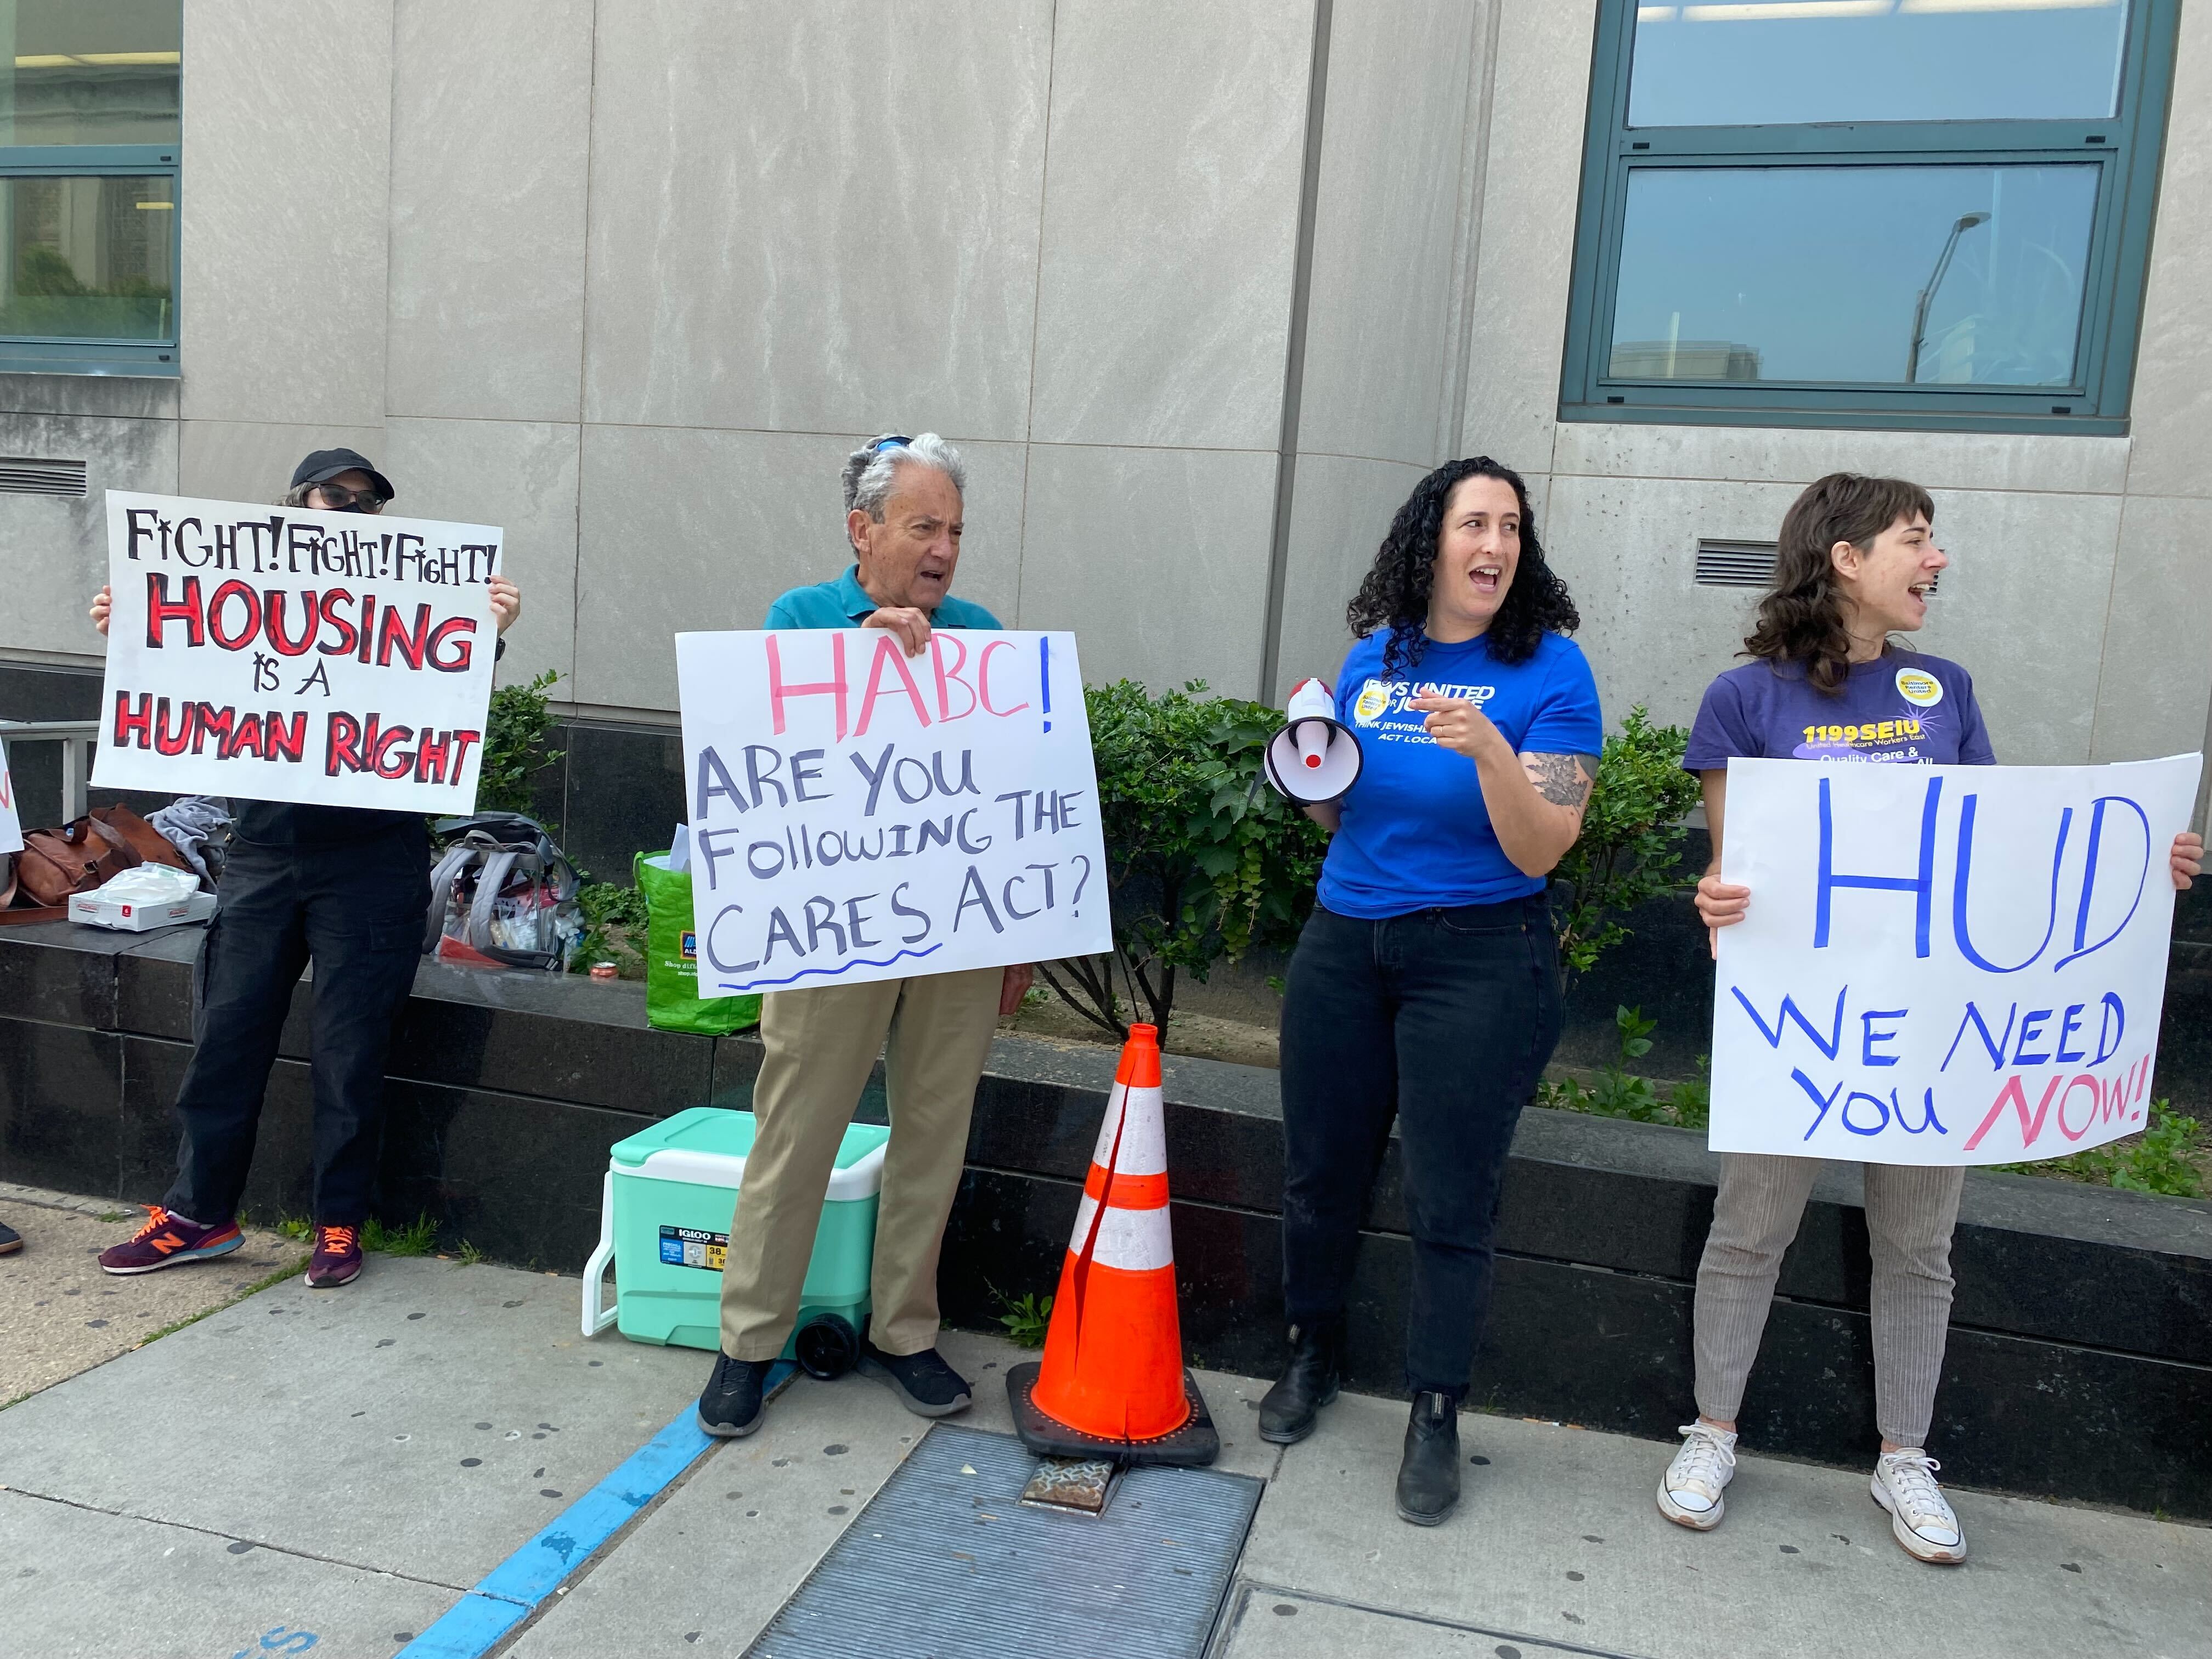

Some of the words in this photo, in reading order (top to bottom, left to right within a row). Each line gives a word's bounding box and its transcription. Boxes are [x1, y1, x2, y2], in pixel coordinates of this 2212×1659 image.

[146, 572, 477, 673] HOUSING
[294, 658, 331, 697] A
[1412, 682, 1496, 701] UNITED
[114, 690, 308, 762] HUMAN
[325, 712, 481, 787] RIGHT
[1355, 720, 1381, 730] THINK
[1378, 733, 1403, 742] ACT
[1802, 719, 1921, 743] 1199SEIU
[1874, 736, 1908, 746] Workers
[1871, 749, 1905, 763] Care
[1908, 746, 1919, 758] &
[696, 744, 834, 820] ARE
[849, 743, 981, 817] YOU
[995, 789, 1085, 842] THE
[1813, 776, 2151, 973] HUD
[707, 882, 931, 973] CARES
[953, 855, 1090, 935] ACT?
[664, 960, 681, 969] Shop
[1730, 984, 1909, 1067] WE
[1940, 991, 2125, 1072] NEED
[1791, 1066, 1948, 1142] YOU
[1963, 1053, 2151, 1151] NOW!
[679, 1229, 711, 1240] IGLOO
